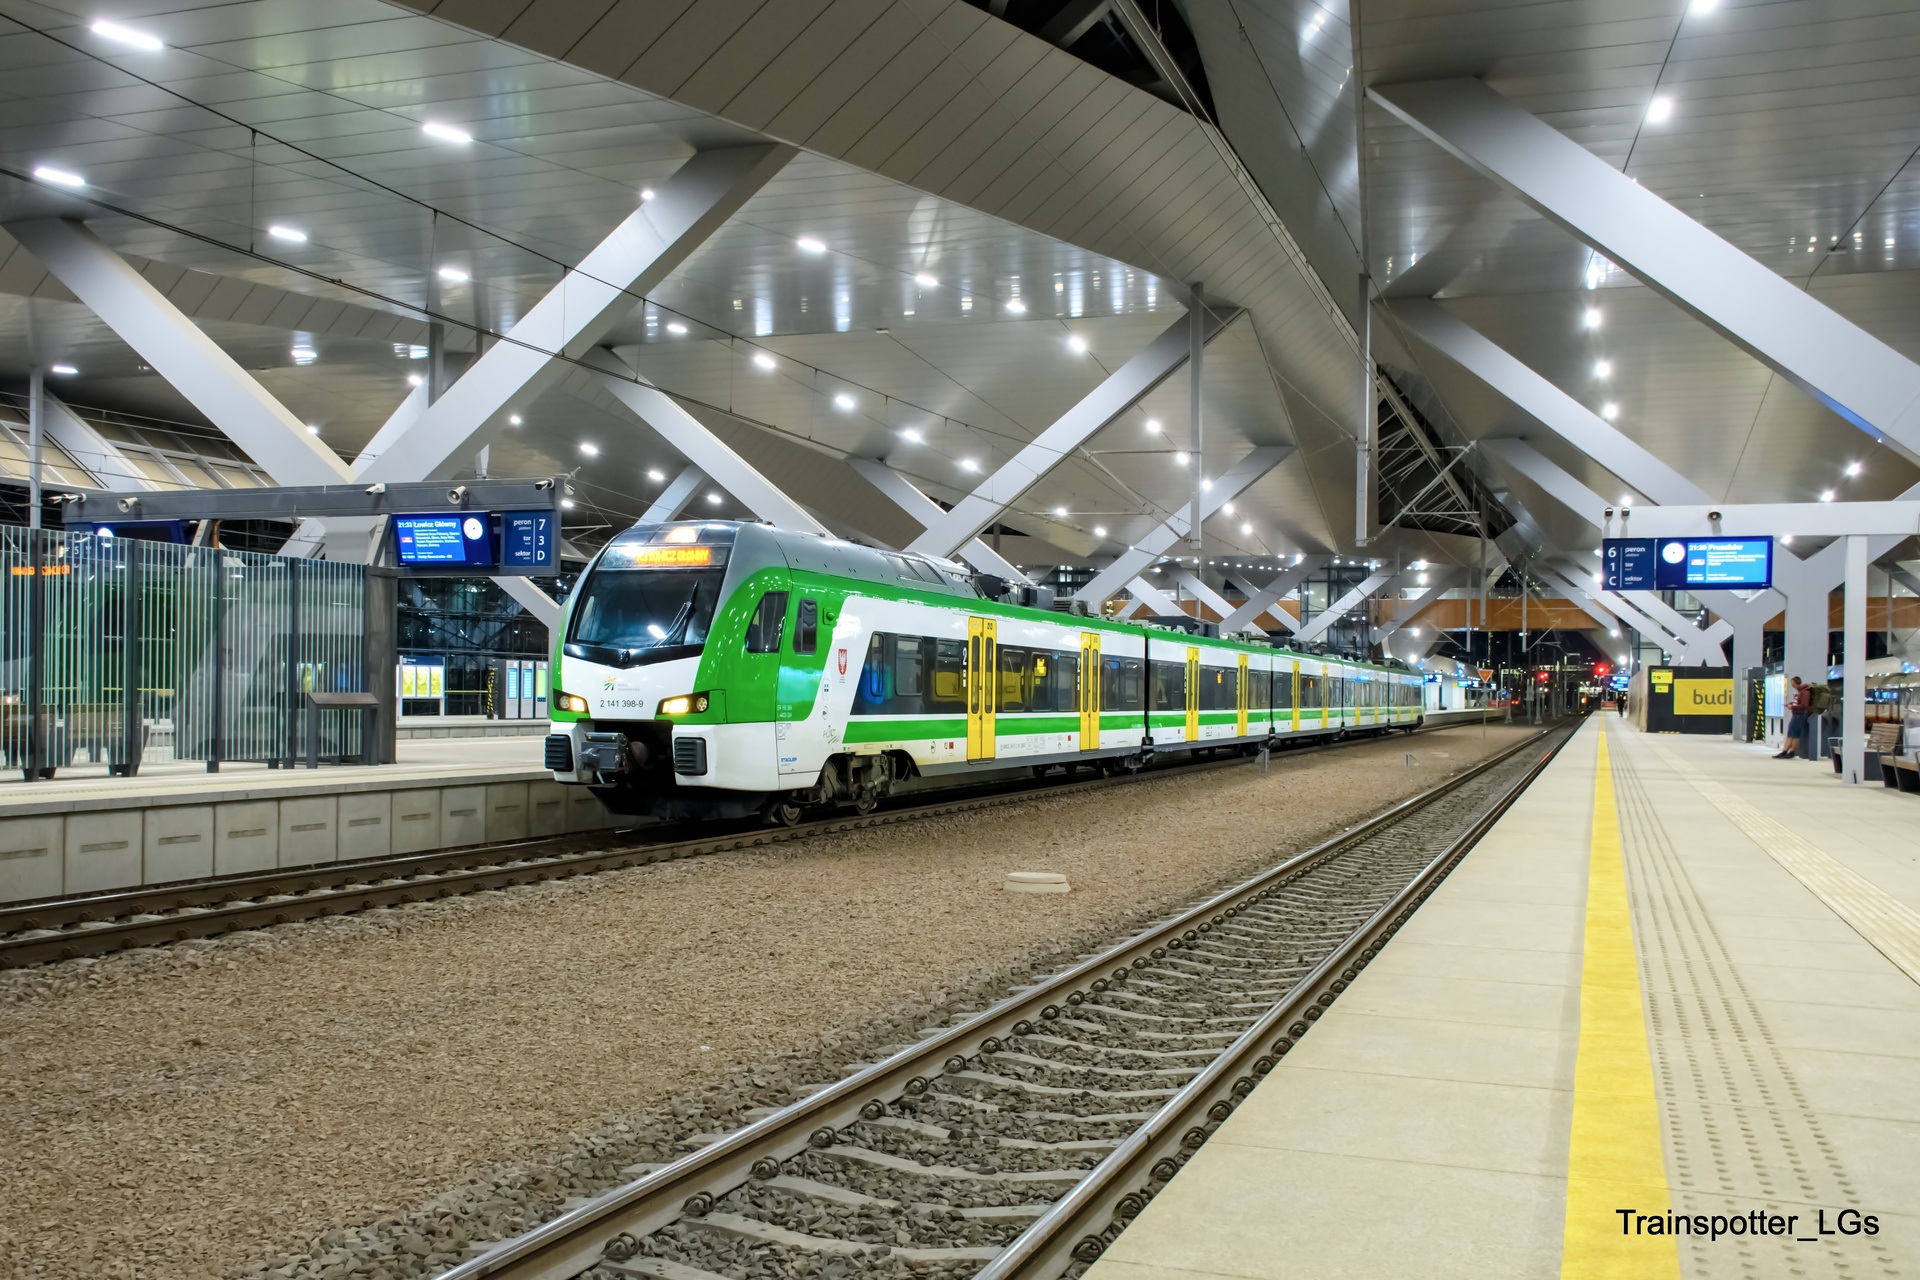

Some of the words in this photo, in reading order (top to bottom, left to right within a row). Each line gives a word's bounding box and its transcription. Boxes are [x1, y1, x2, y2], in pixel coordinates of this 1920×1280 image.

[538, 519, 546, 530] 7
[538, 536, 544, 545] 3
[537, 550, 545, 560] D
[1608, 547, 1616, 558] 6
[1610, 562, 1615, 571] 1
[1609, 576, 1616, 586] C
[962, 647, 967, 665] 2
[1693, 689, 1732, 705] budi
